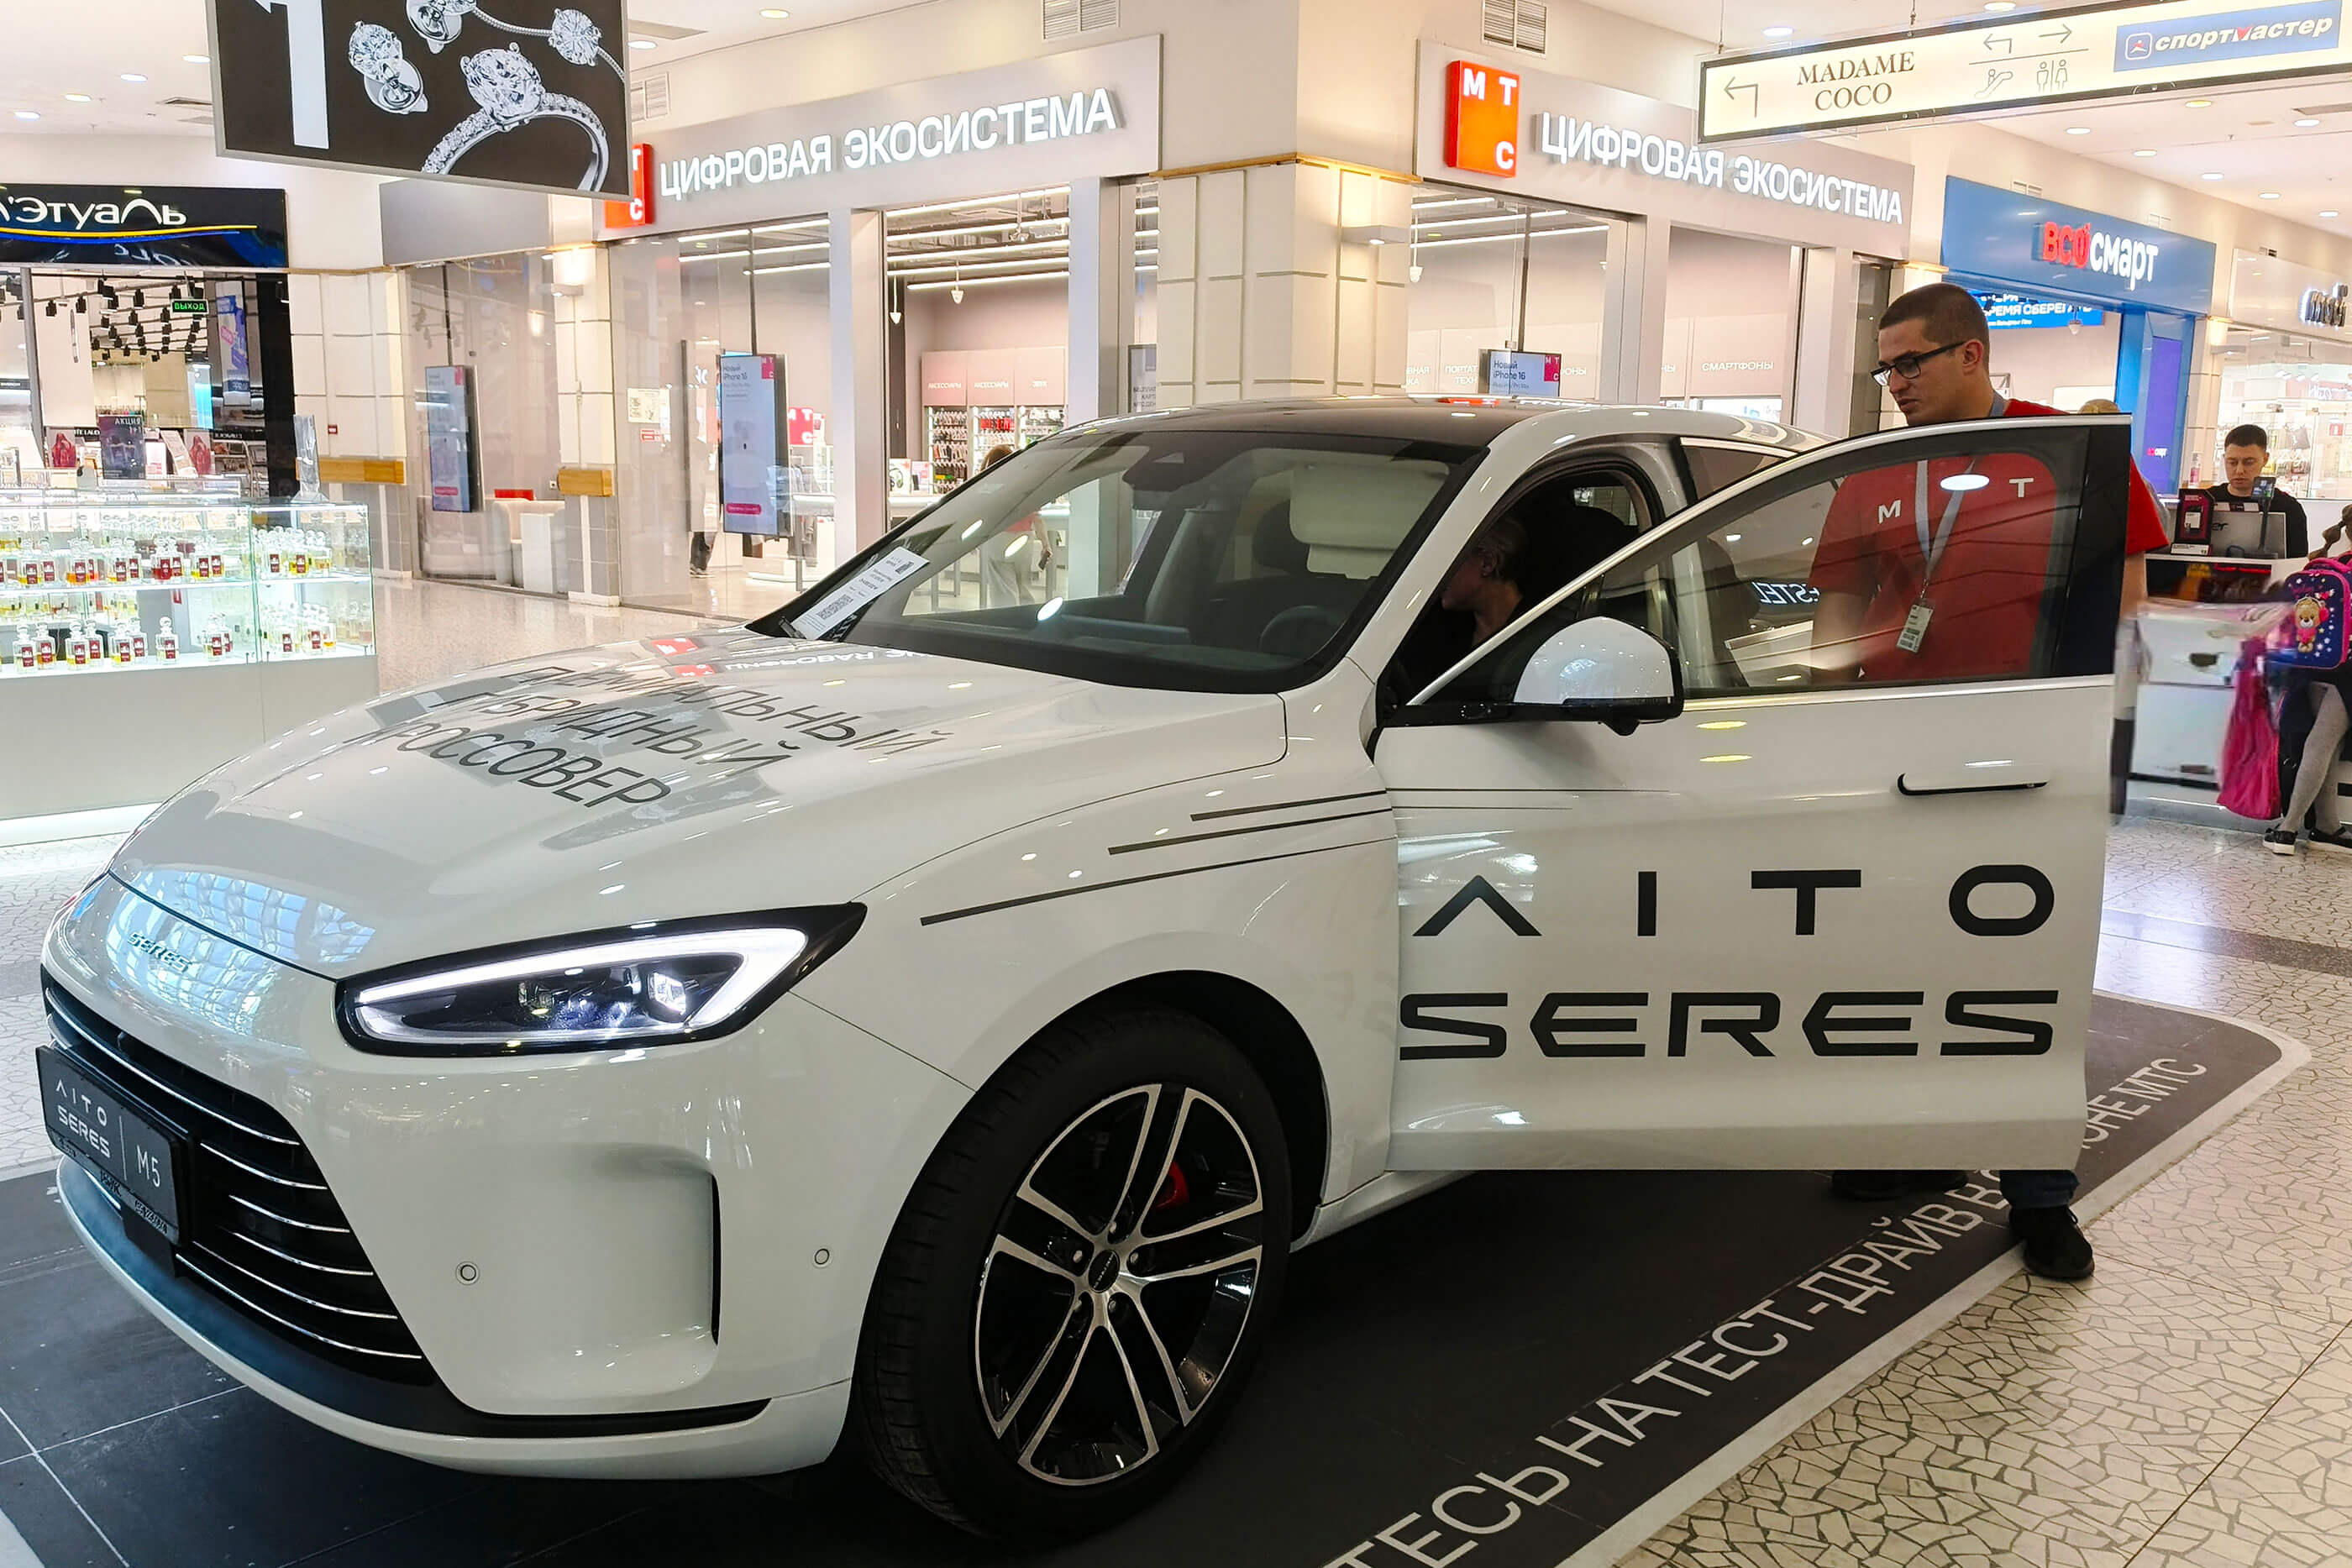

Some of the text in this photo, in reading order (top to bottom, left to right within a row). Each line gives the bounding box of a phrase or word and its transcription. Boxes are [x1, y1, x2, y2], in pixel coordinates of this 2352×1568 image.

[1797, 51, 1916, 87] MADAME
[1814, 82, 1893, 111] COCO
[660, 87, 1116, 202] ЦИФРОВАЯ ЭКОСИСТЕМА
[1541, 112, 1903, 224] ЦИФРОВАЯ ЭКОСИСТЕМА
[174, 302, 205, 311] ВЫХОД
[1702, 361, 1774, 371] СМАРТФОНЫ
[127, 931, 192, 973] SERES
[1399, 990, 2059, 1061] SERES
[57, 1104, 111, 1159] SERES
[137, 1144, 160, 1188] M5
[1536, 1392, 1683, 1467] НА
[1631, 1203, 1982, 1397] ТЕСТ-ДРАЙВ
[2108, 1058, 2208, 1102] МТС
